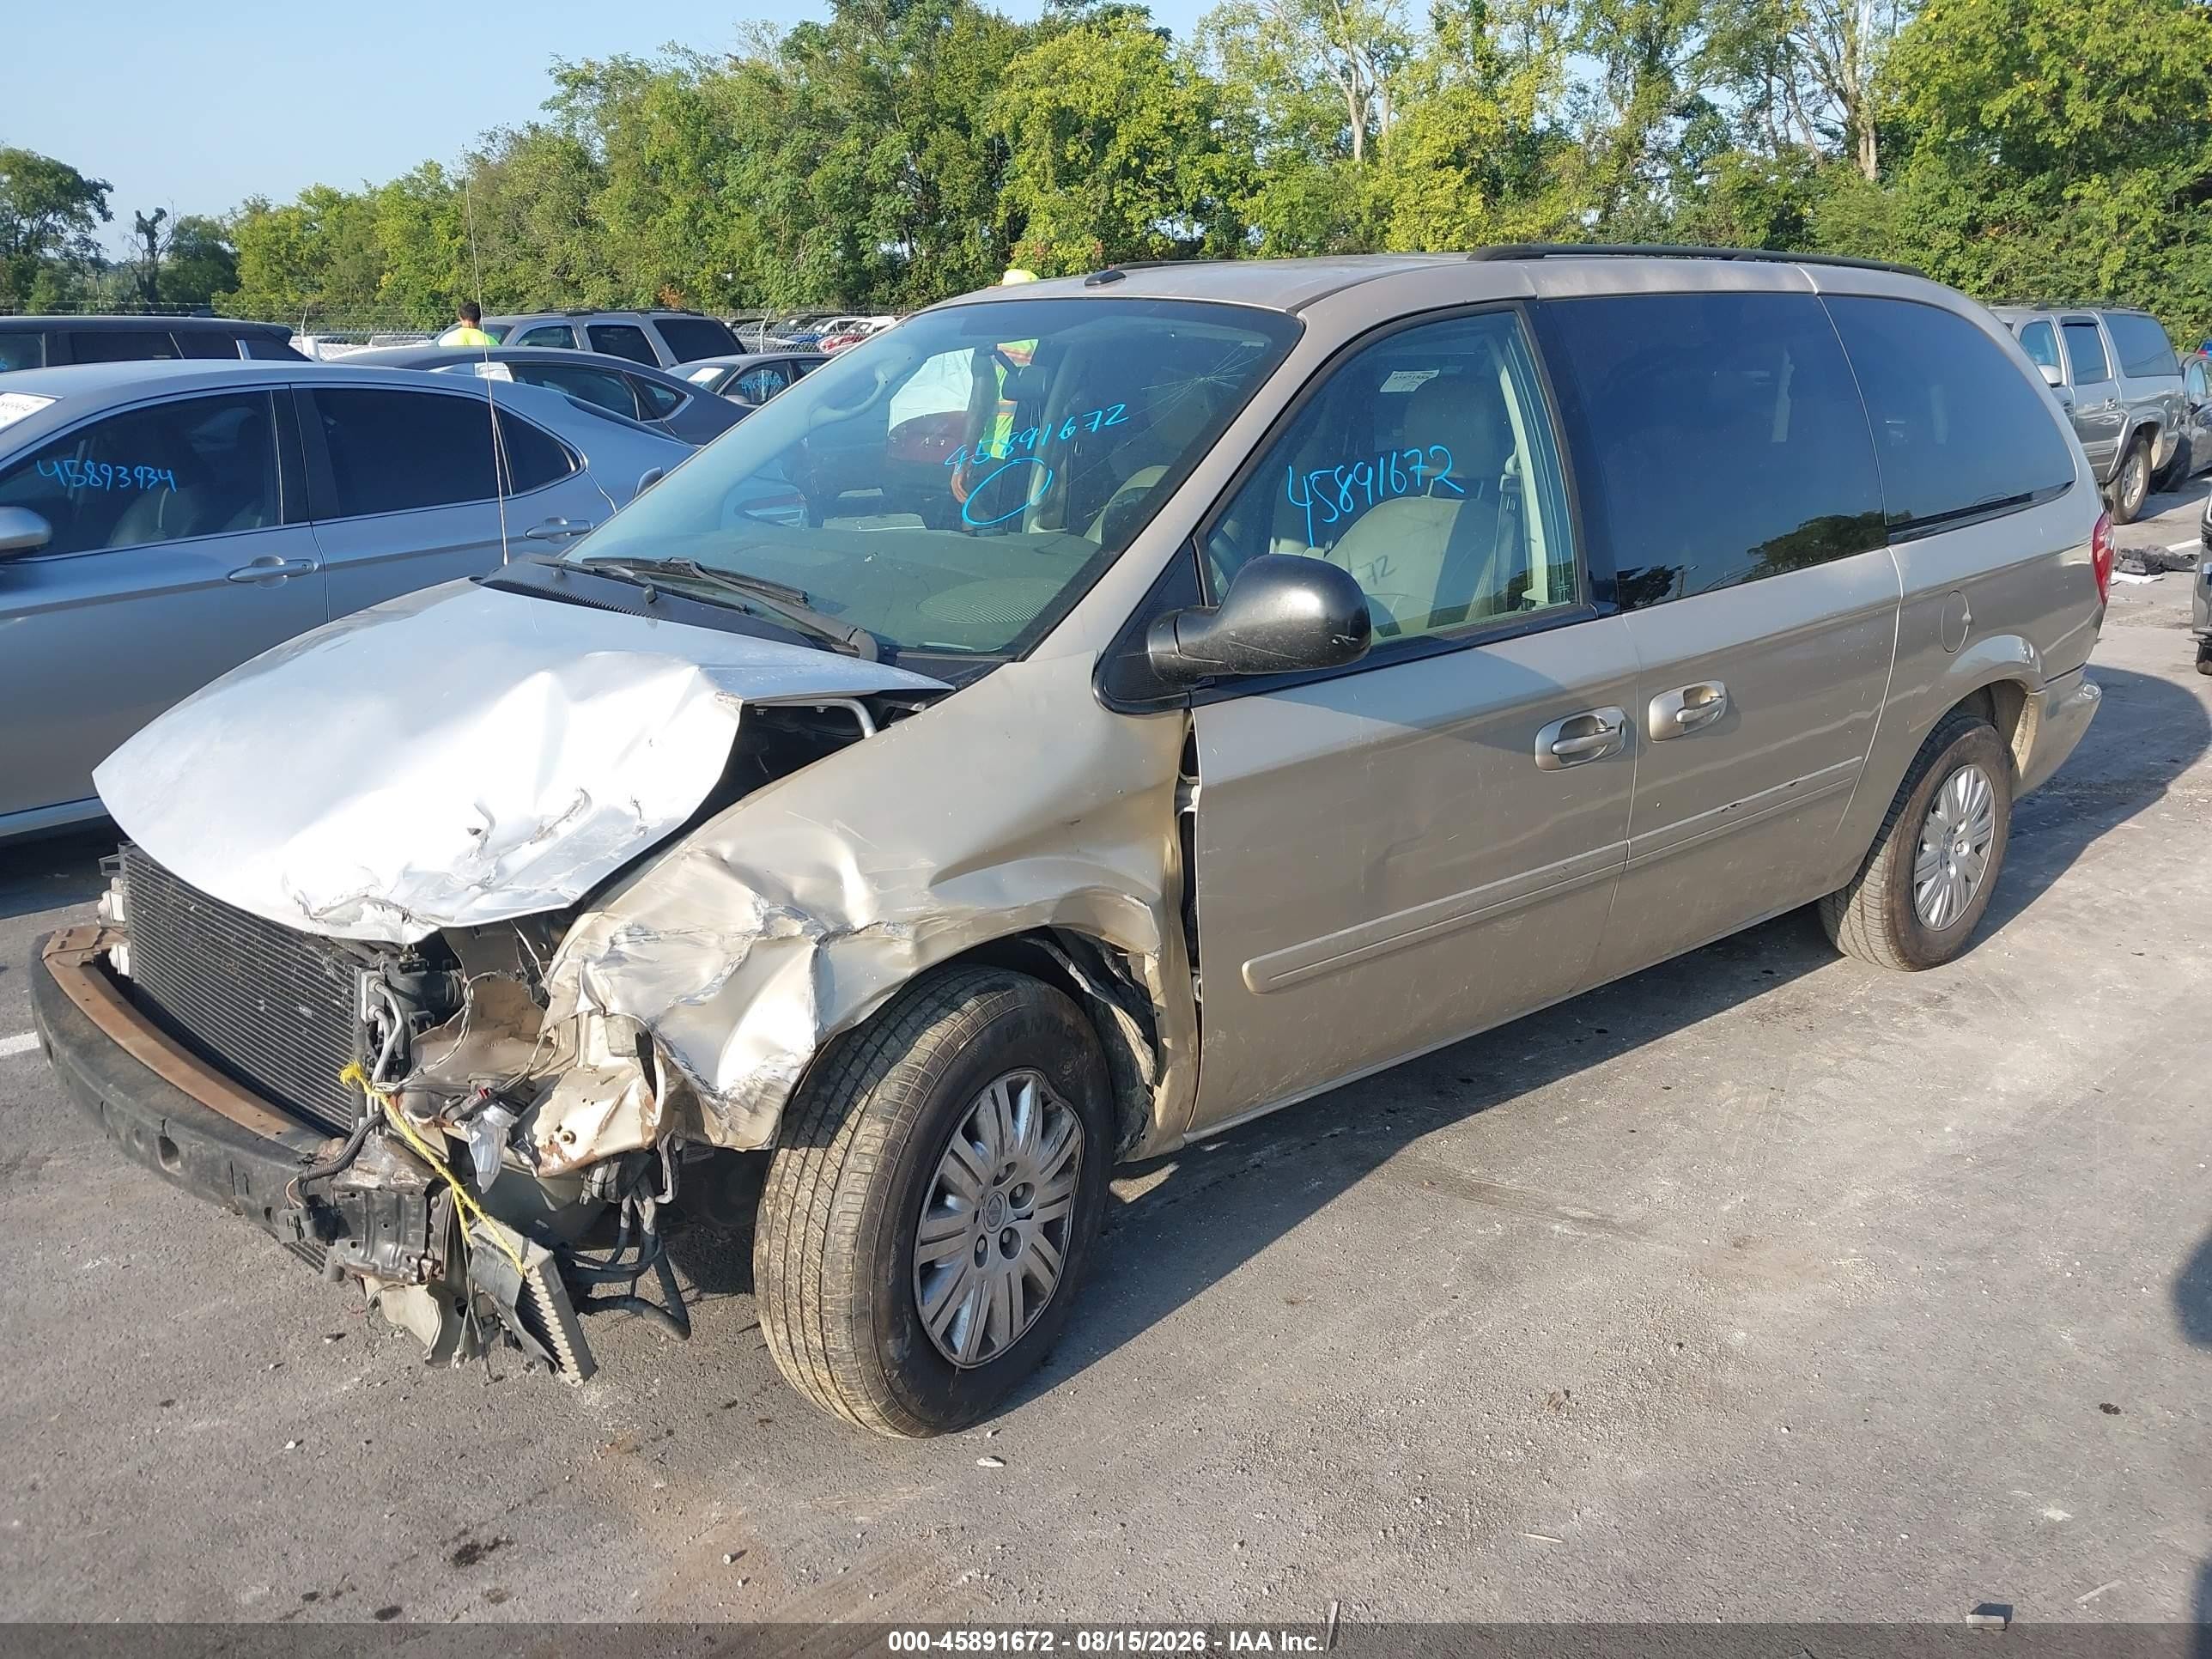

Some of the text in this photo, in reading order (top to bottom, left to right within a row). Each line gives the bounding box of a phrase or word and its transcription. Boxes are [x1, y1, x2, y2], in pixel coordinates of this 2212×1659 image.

[944, 403, 1129, 468] 45891672
[36, 459, 178, 493] 45893934
[1286, 443, 1465, 547] 45891672
